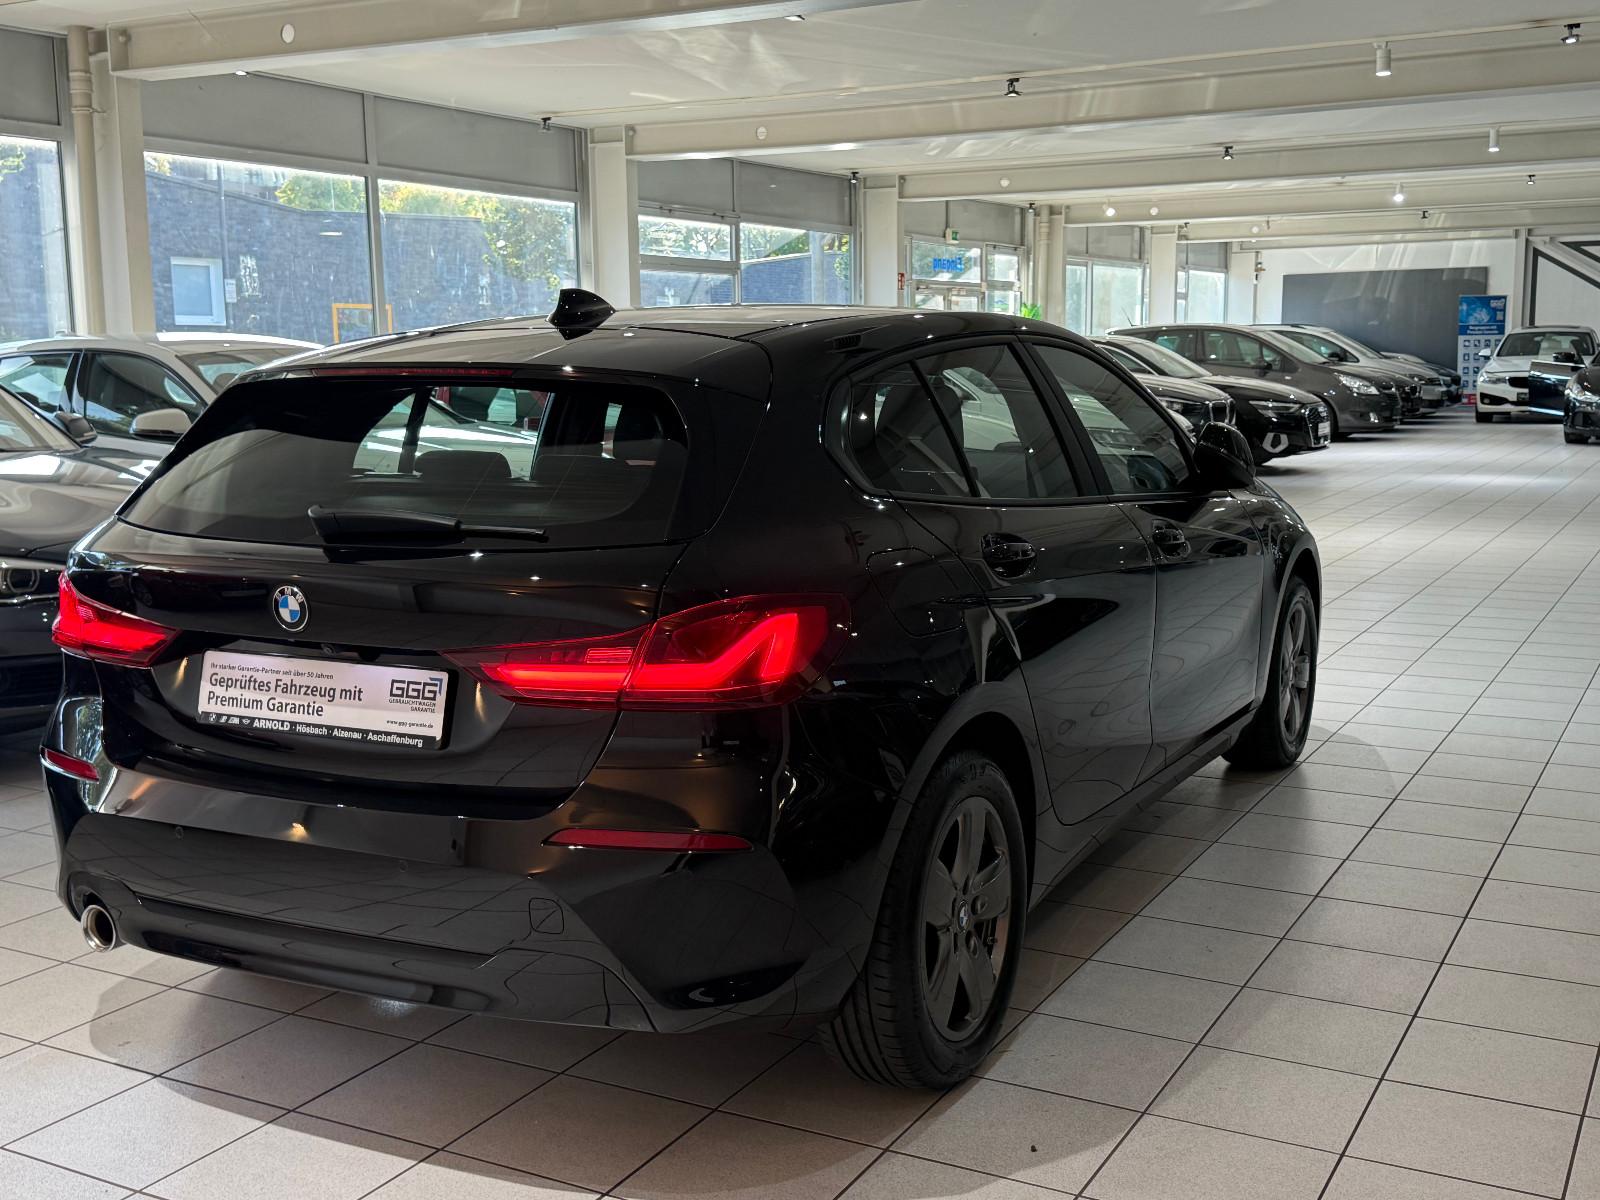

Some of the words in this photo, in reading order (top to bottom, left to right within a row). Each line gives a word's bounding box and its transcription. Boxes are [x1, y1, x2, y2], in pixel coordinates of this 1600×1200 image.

[238, 665, 282, 674] Garantie-Partner
[315, 672, 334, 680] Jahren
[209, 672, 272, 692] Geprüftes
[274, 678, 337, 702] Fahrzeug
[339, 685, 364, 702] mit
[389, 678, 439, 702] GGG
[207, 690, 263, 710] Premium
[266, 696, 324, 716] Garantie
[388, 698, 437, 708] GEBRAUCHTWAGEN
[253, 718, 291, 731] ARNOLD
[296, 723, 328, 736] Hösbach
[332, 728, 362, 739] Alzenau
[367, 732, 424, 748] Aschaffenburg
